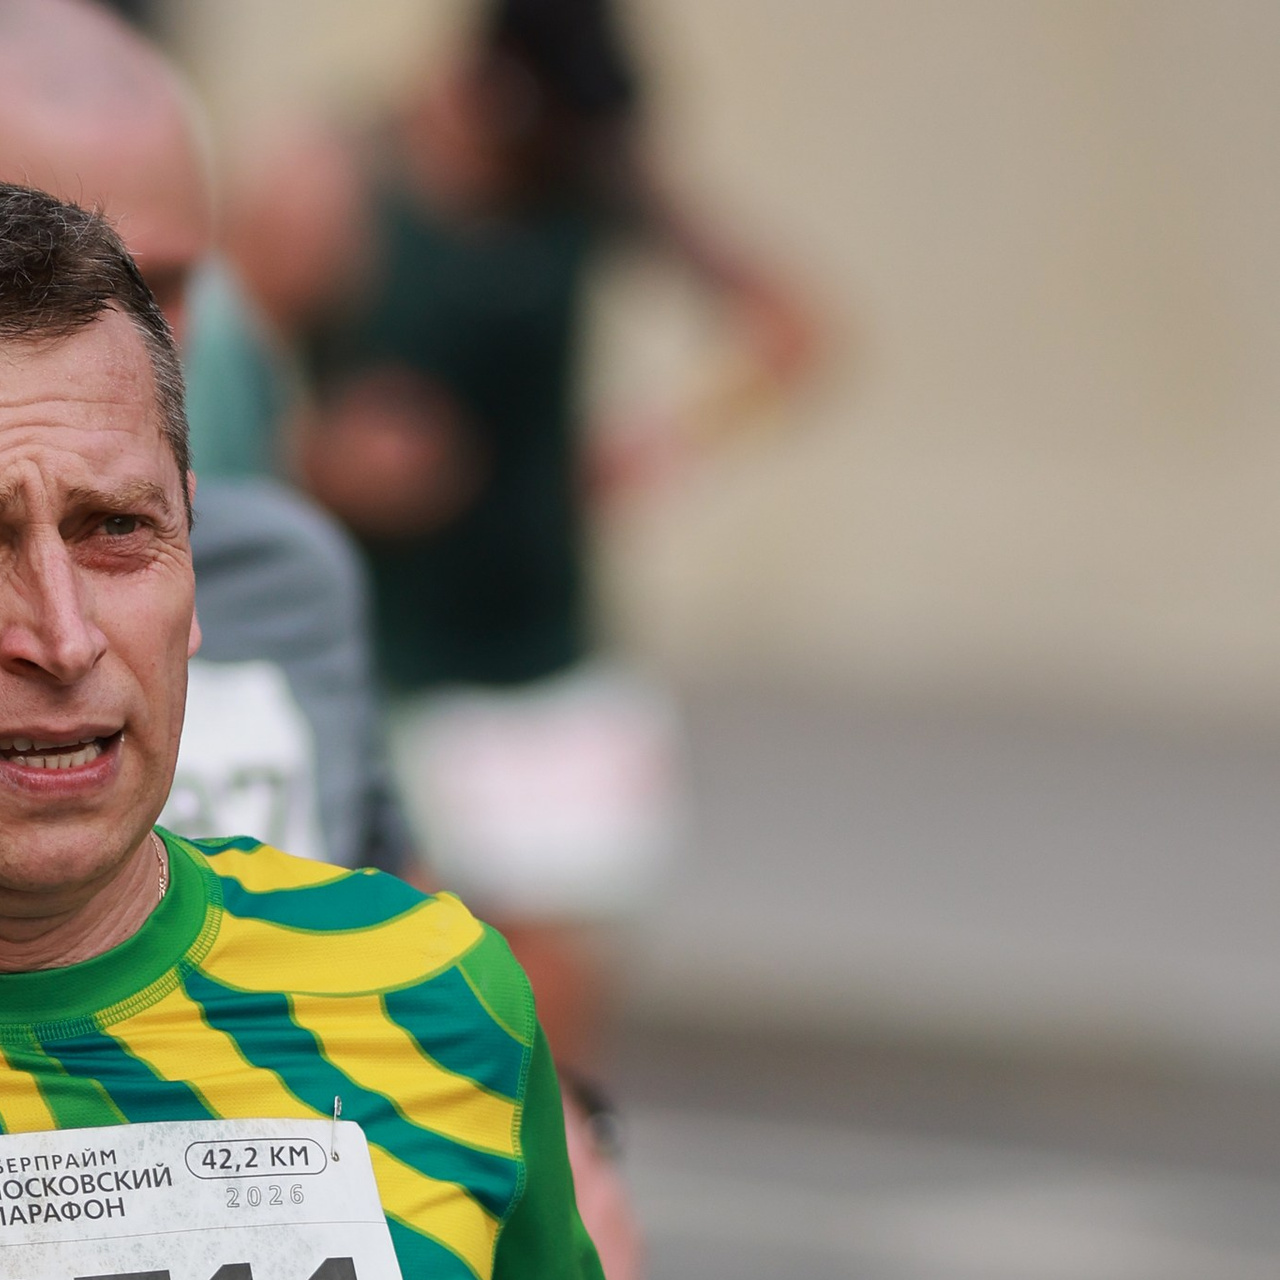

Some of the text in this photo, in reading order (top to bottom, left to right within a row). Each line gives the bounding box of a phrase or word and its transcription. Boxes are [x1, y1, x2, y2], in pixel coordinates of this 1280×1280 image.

[202, 1146, 310, 1172] 42,2 КМ
[226, 1184, 305, 1208] 2026
